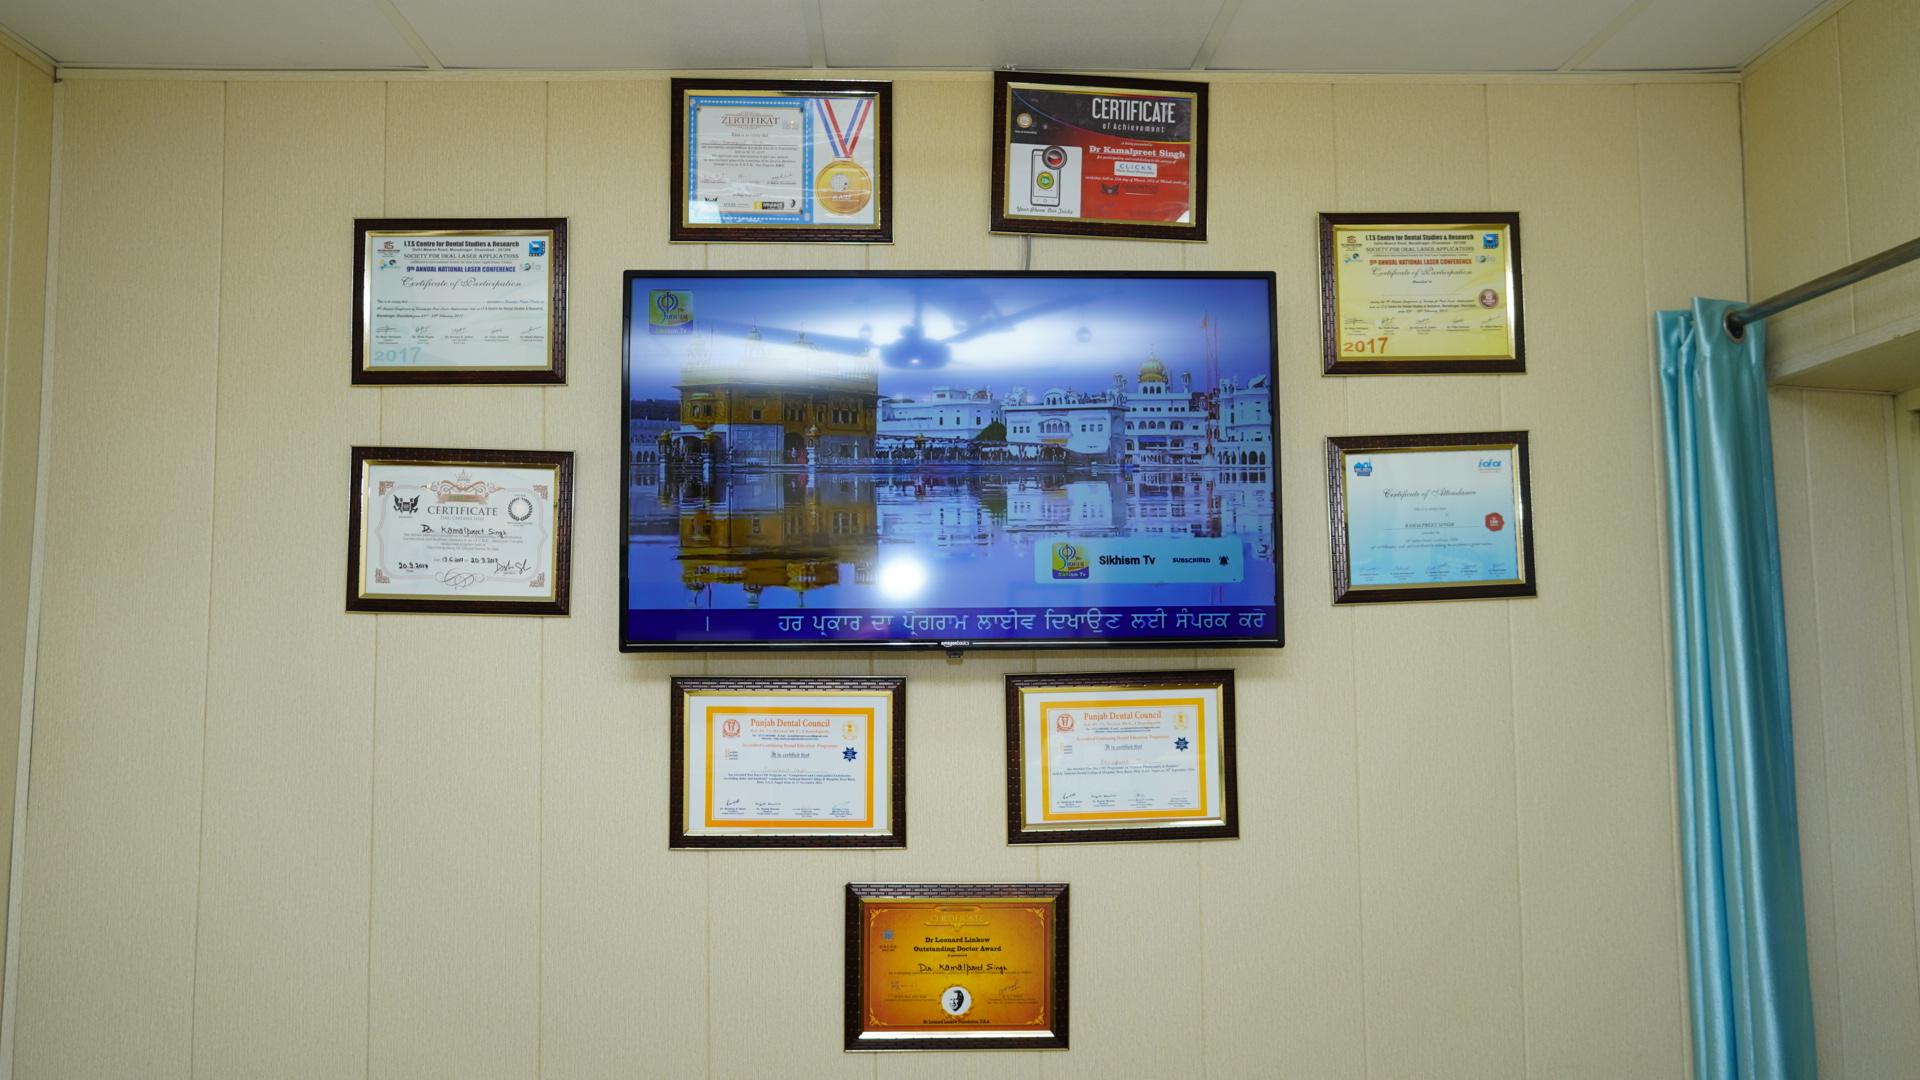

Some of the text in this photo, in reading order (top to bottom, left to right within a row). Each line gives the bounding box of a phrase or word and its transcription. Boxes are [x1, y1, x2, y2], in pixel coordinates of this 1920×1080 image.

[1092, 98, 1176, 123] CERTIFICATE
[721, 116, 779, 125] ZERTIFIKAT
[1113, 123, 1164, 133] Achievement
[1103, 146, 1156, 157] Kamalpreet
[1159, 149, 1185, 159] Singh
[401, 276, 447, 290] Certificate
[460, 277, 522, 290] Participation
[1343, 336, 1389, 354] 2017
[373, 346, 422, 363] 2017
[1383, 489, 1420, 501] Certificate
[427, 506, 498, 516] CERTIFICATE
[1099, 555, 1156, 565] Sikhism Tv
[778, 616, 804, 631] ਹਰ
[813, 616, 863, 637] ਪ੍ਰਕਾਰ
[871, 615, 894, 631] ਦਾ
[902, 611, 968, 637] ਪ੍ਰੋਗਰਾਮ
[977, 610, 1036, 630] ਲਾਈਵ
[1045, 608, 1123, 633] ਦਿਖਾਉਣ
[1131, 609, 1167, 629] ਲਈ
[1176, 608, 1231, 629] ਸੰਪਰਕ
[1238, 608, 1267, 628] ਕਰੋ
[1084, 711, 1162, 721] Punjab Dental Council
[751, 718, 830, 728] Punjab Dental Council
